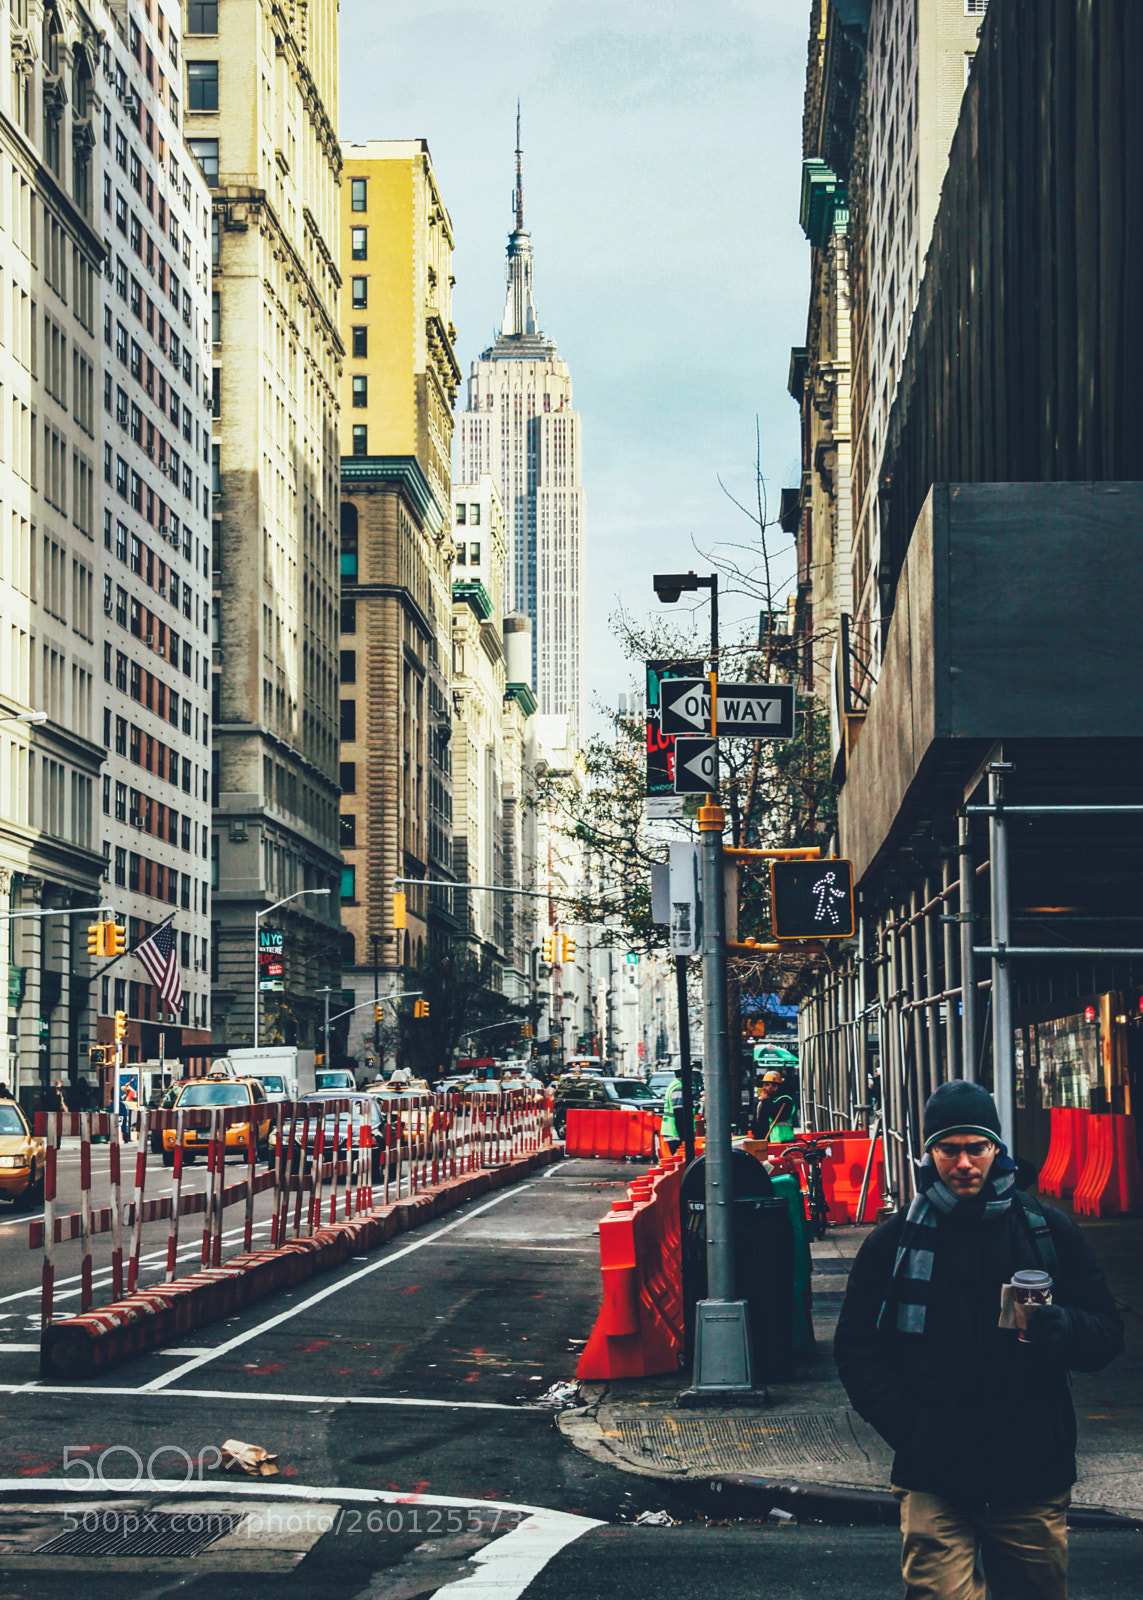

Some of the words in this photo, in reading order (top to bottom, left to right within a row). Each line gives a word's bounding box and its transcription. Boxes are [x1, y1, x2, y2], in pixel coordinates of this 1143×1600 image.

[685, 696, 711, 717] ON
[724, 700, 772, 721] WAY
[261, 932, 283, 946] NYC
